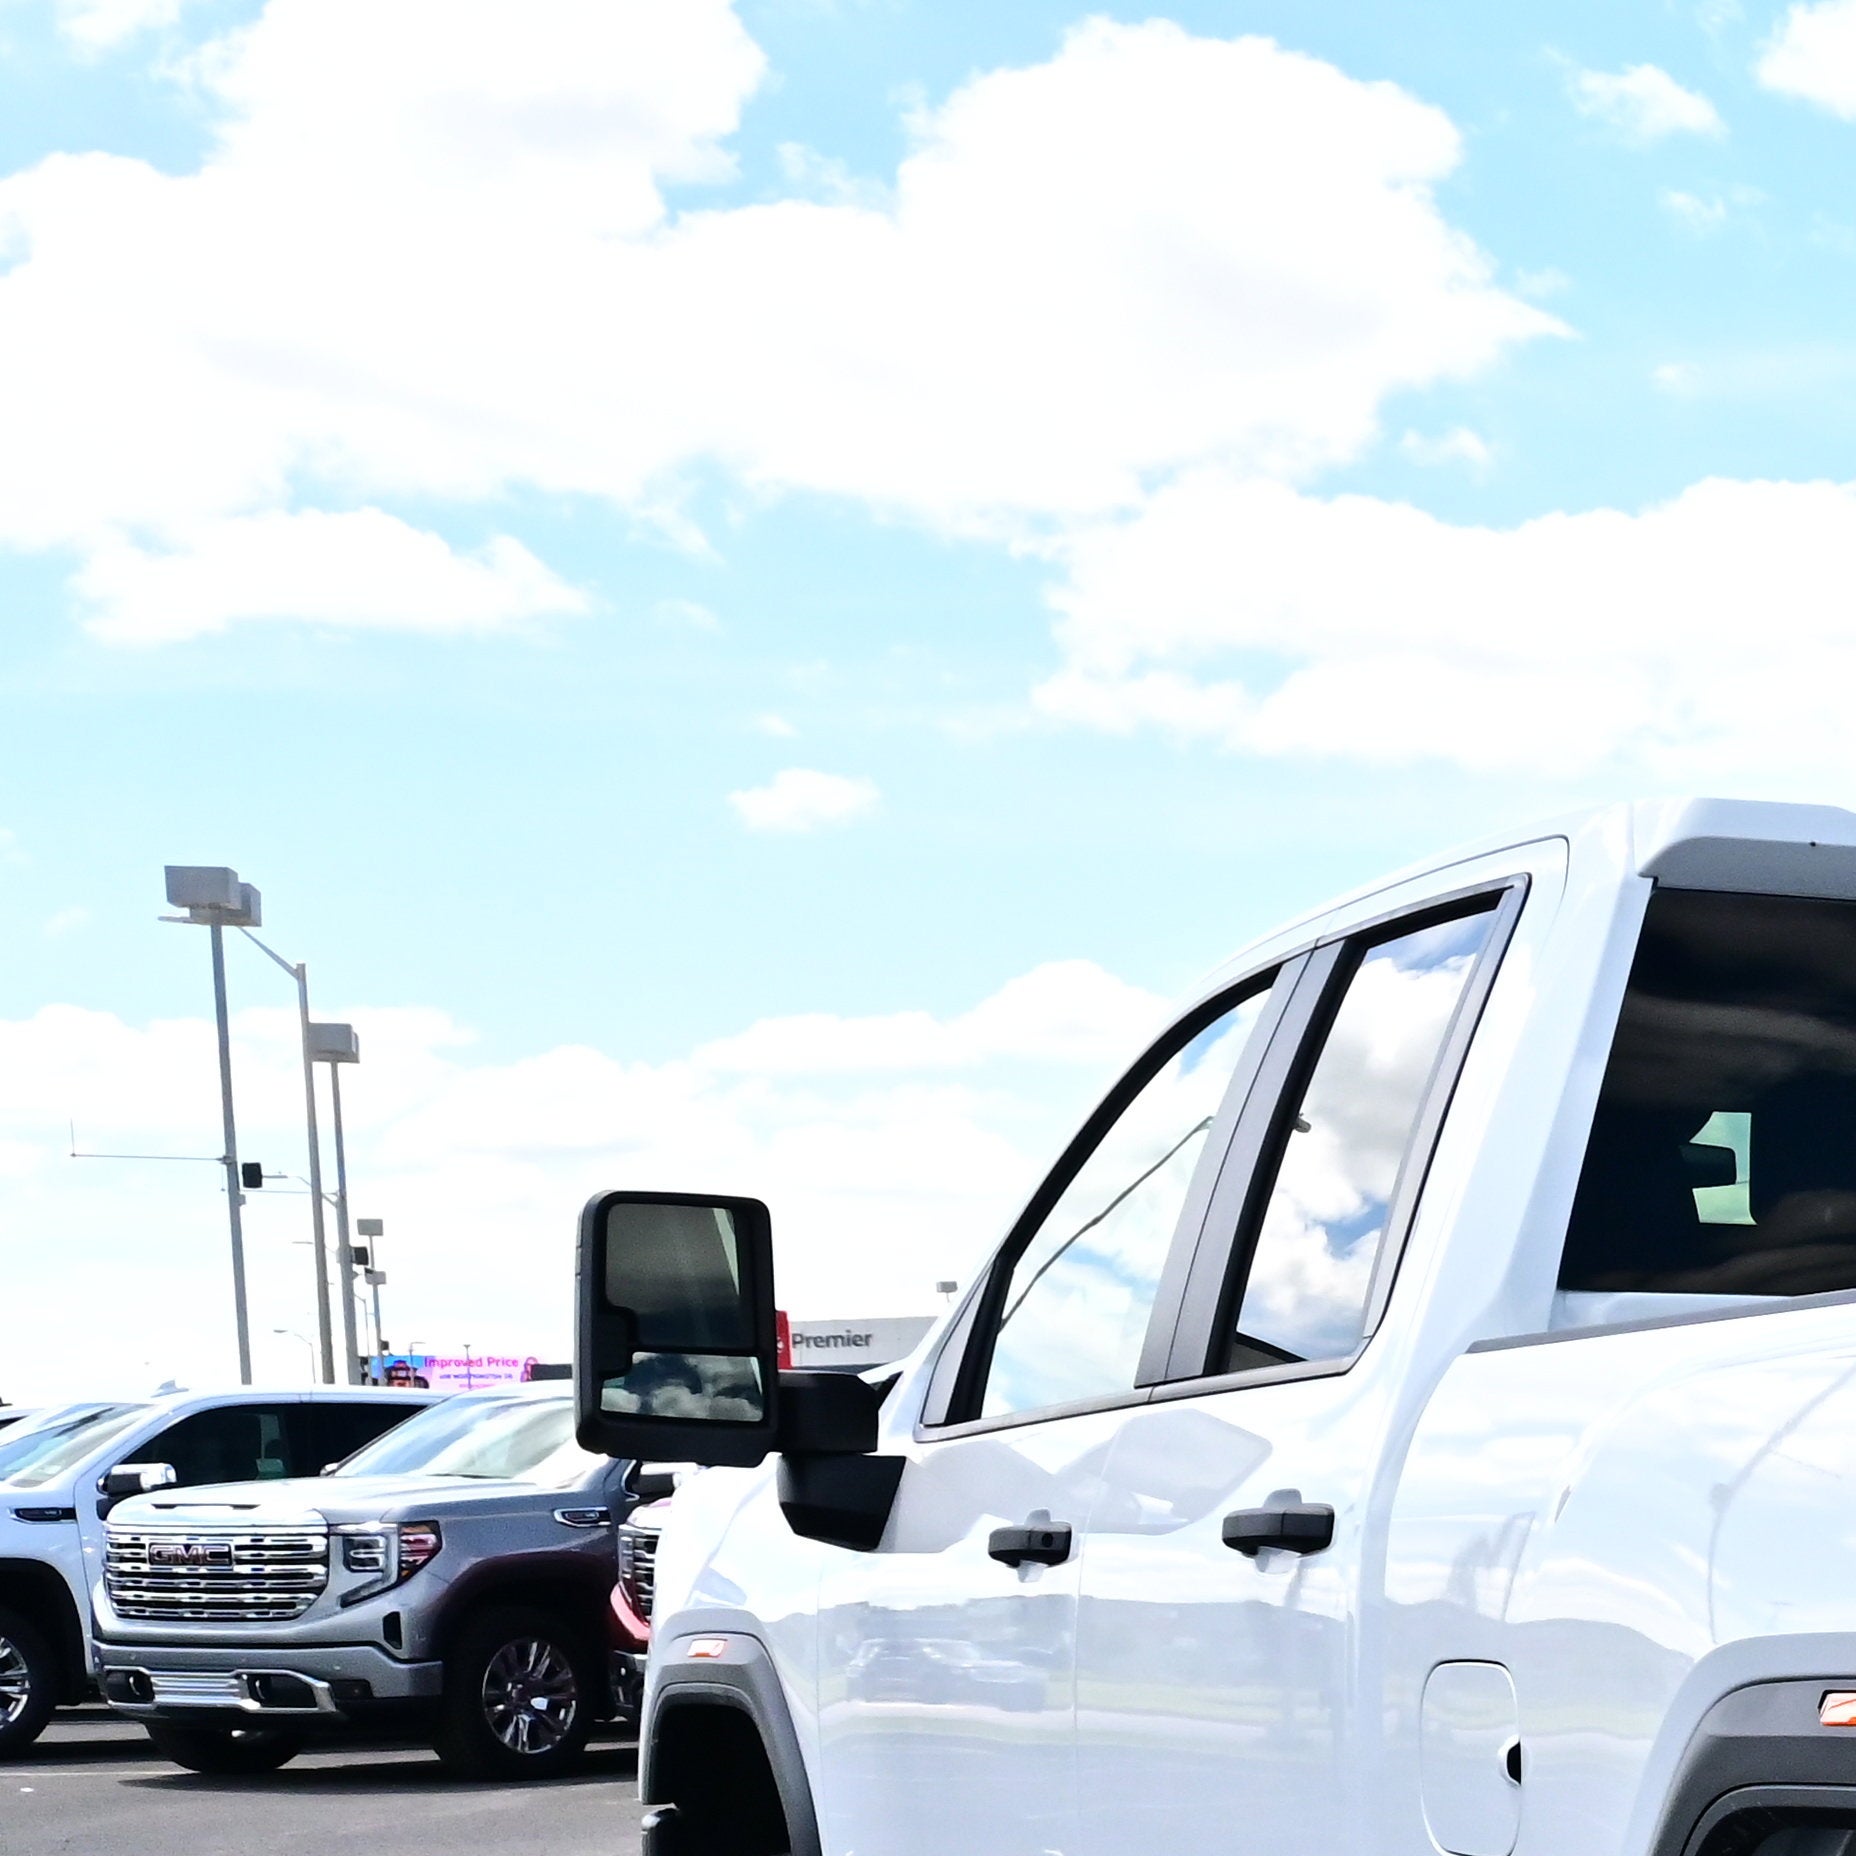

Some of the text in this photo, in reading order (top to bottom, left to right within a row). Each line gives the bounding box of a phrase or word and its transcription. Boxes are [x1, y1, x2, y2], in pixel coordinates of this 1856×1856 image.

[791, 1329, 872, 1349] Premier
[424, 1356, 519, 1368] Improved Price
[149, 1544, 230, 1566] GMC
